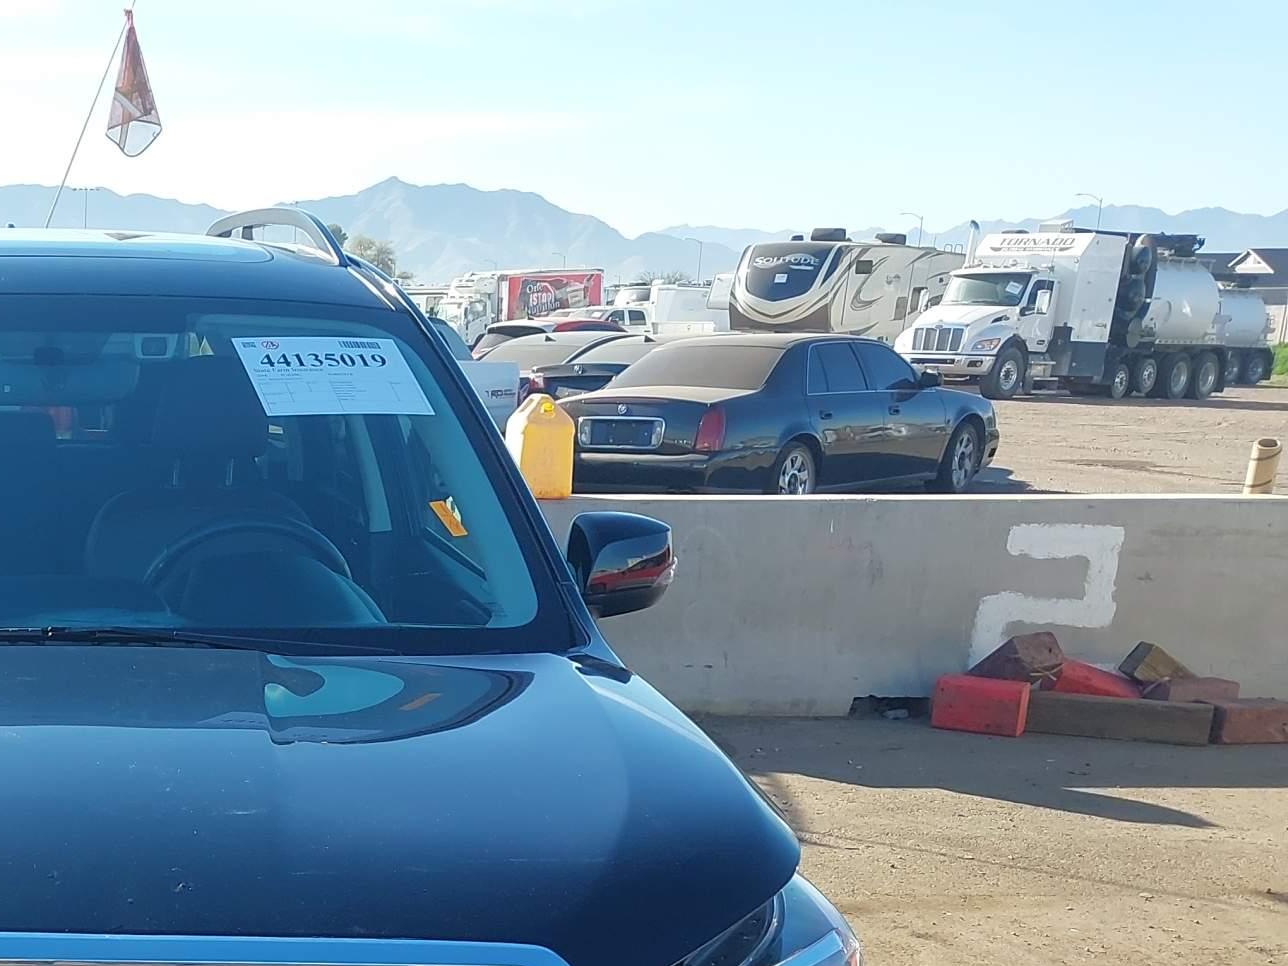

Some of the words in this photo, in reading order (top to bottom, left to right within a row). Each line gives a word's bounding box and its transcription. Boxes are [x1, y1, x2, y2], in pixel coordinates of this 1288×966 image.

[999, 237, 1075, 246] TORNADO
[753, 256, 820, 266] SOLITUDE
[260, 352, 387, 368] 44135019
